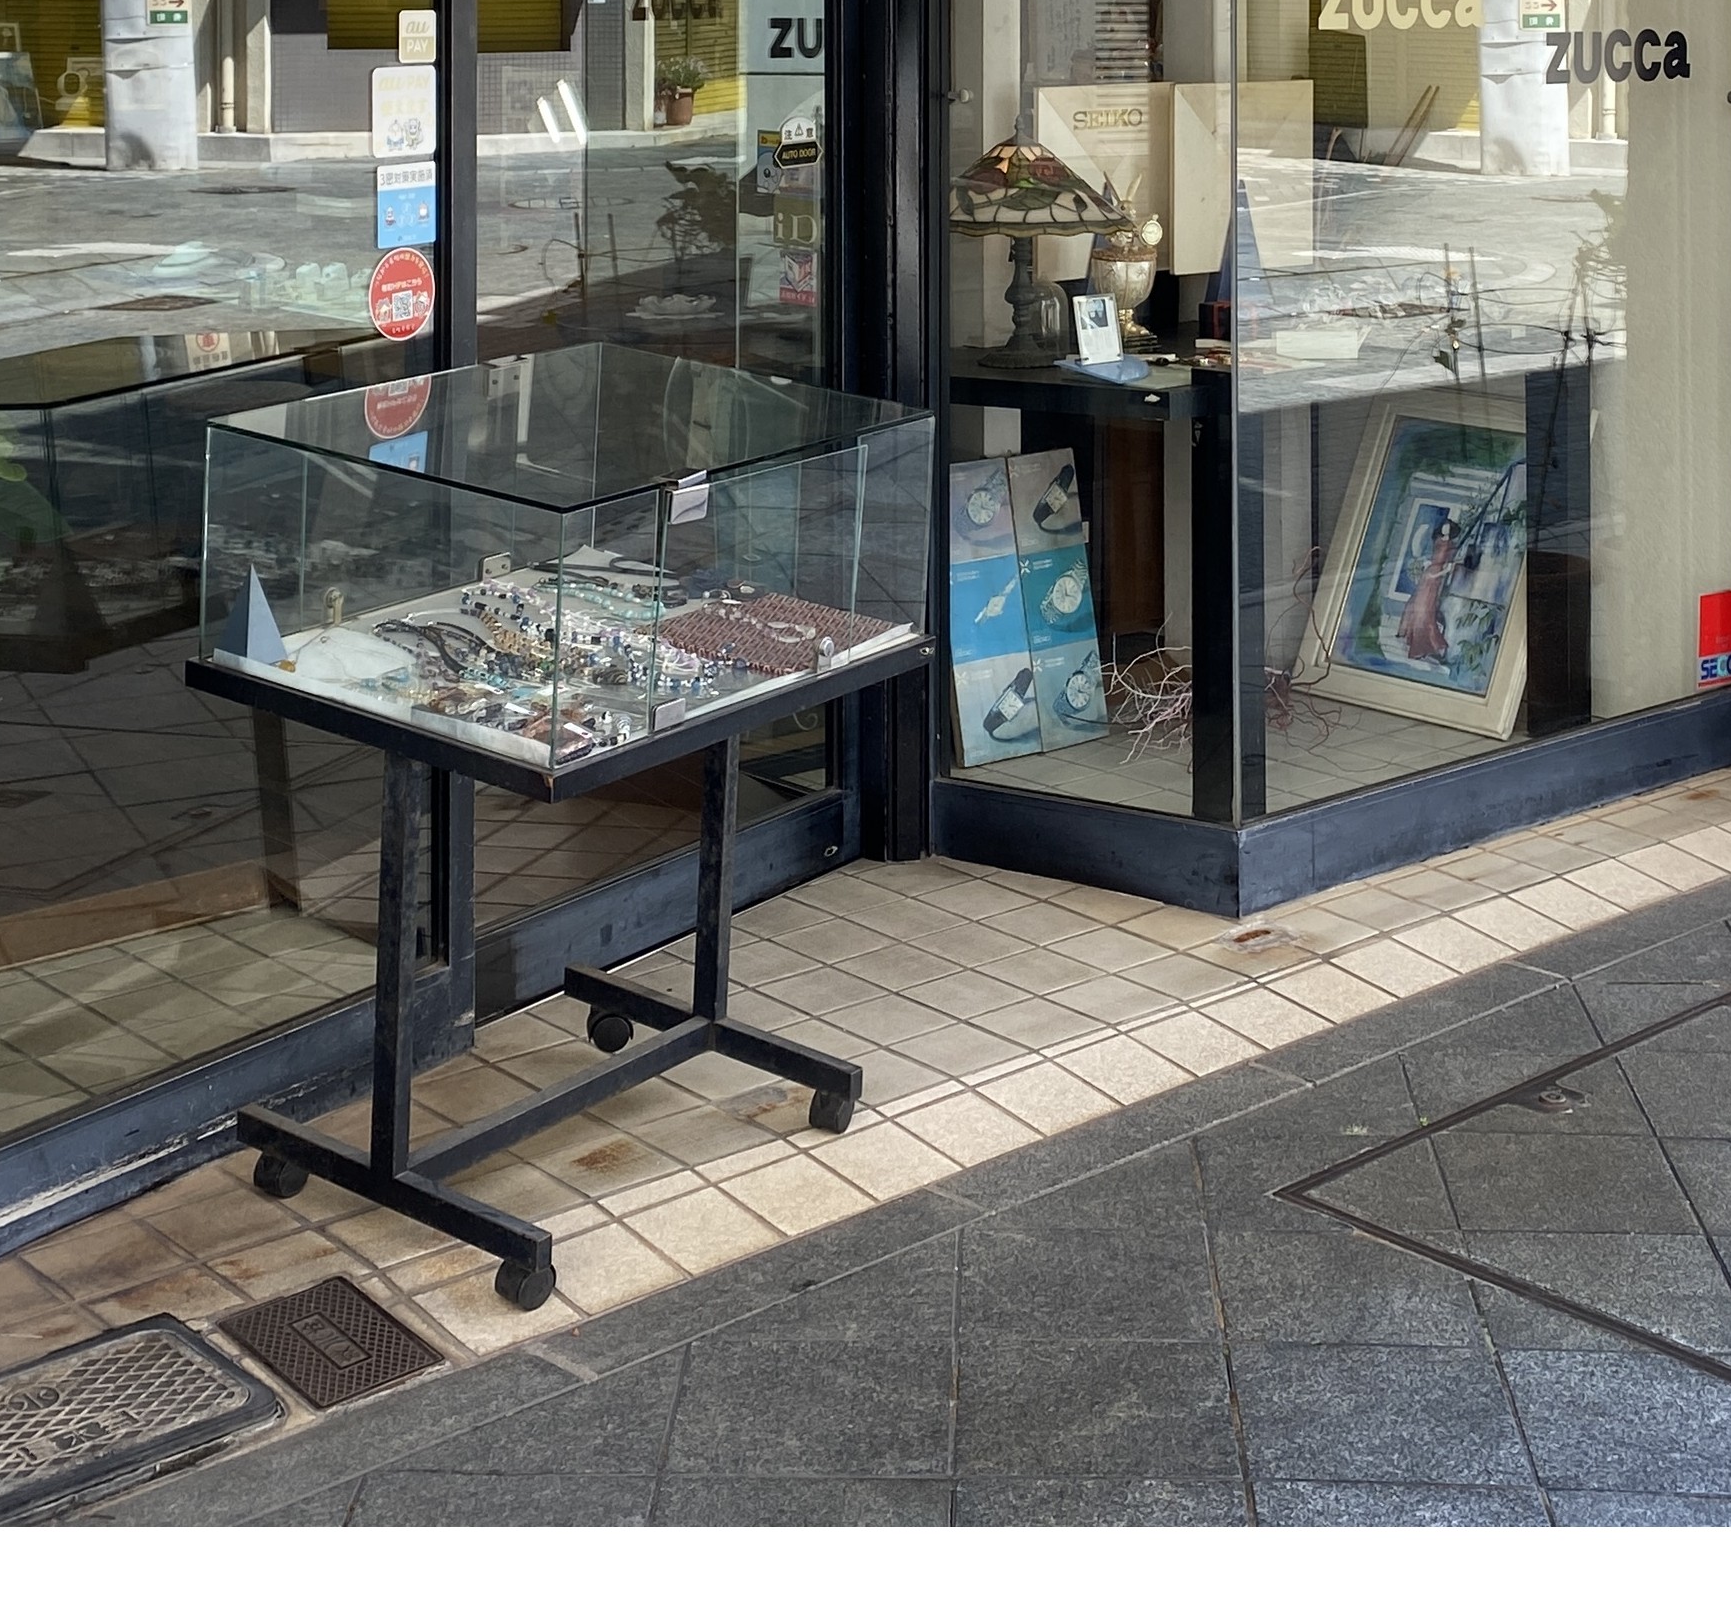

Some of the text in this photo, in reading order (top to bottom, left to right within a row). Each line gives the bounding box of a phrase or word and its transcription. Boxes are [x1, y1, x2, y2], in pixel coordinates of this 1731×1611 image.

[405, 20, 430, 35] au
[406, 38, 429, 54] PAY
[1072, 107, 1144, 131] SEIKO
[781, 146, 817, 160] AUTO DOOR
[776, 211, 819, 245] iD
